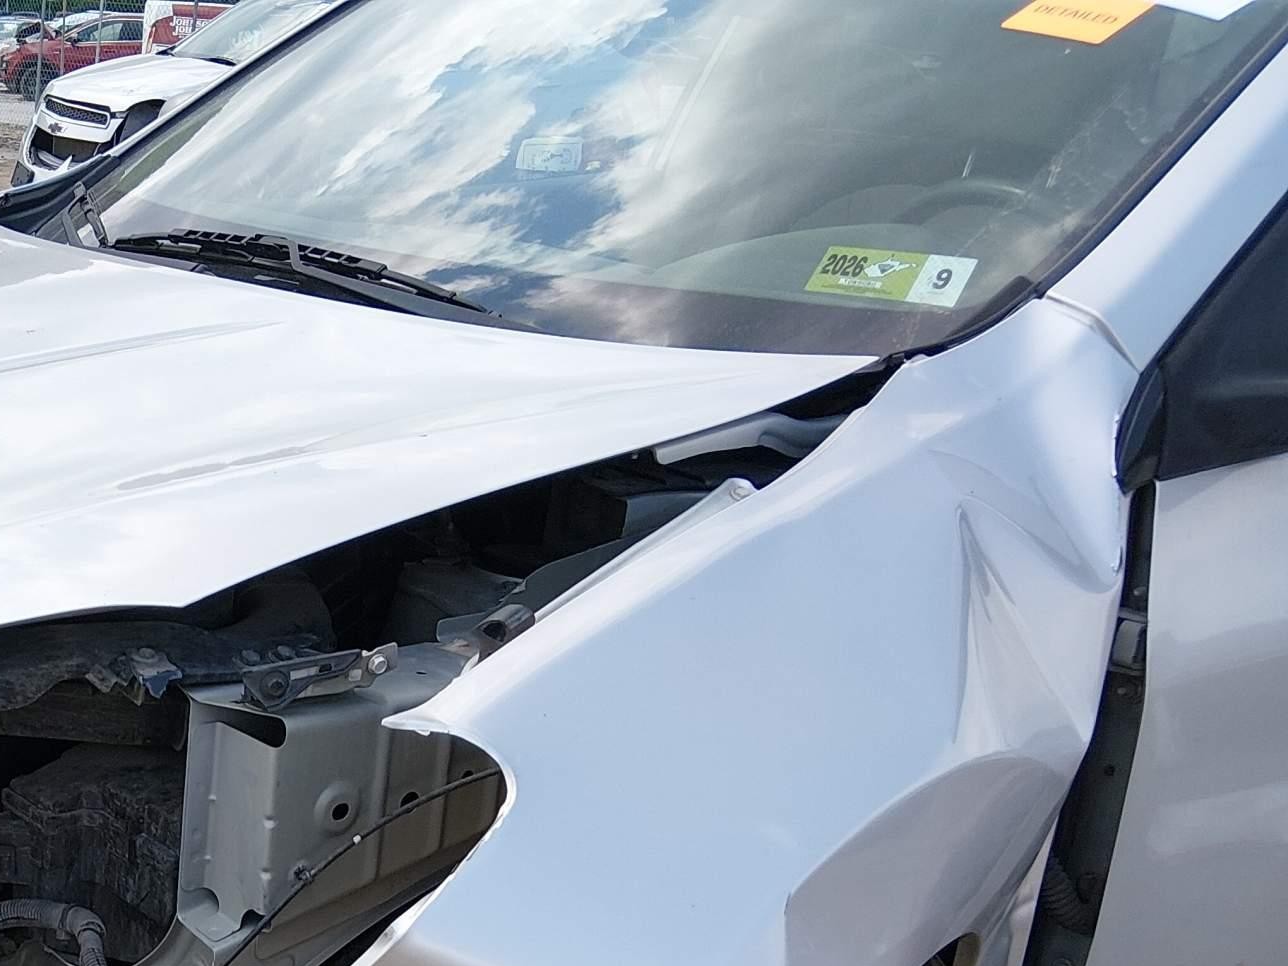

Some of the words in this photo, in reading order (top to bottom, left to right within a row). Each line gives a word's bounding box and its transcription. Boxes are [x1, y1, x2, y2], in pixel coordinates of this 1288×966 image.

[1033, 5, 1119, 24] DETAILED
[820, 253, 868, 277] 2026
[932, 268, 953, 290] 9
